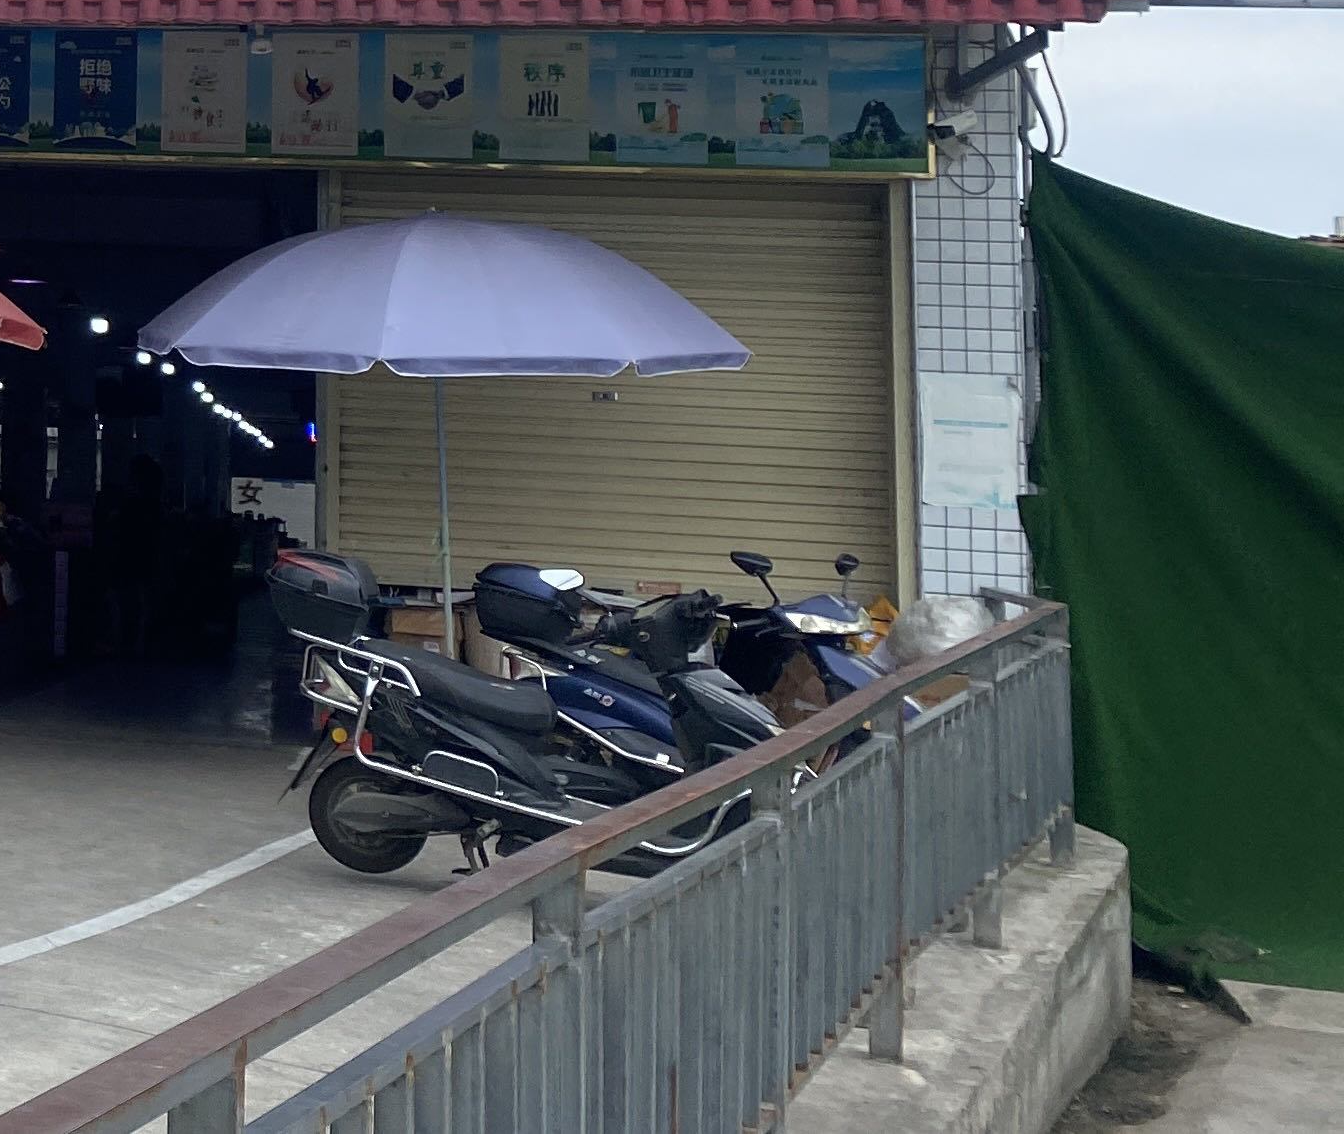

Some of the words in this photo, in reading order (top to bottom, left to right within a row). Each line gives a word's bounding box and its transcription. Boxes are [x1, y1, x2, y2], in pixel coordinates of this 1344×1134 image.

[79, 58, 113, 76] 拒绝
[522, 61, 566, 82] 秩序
[79, 76, 113, 94] 野味
[238, 481, 263, 506] 女
